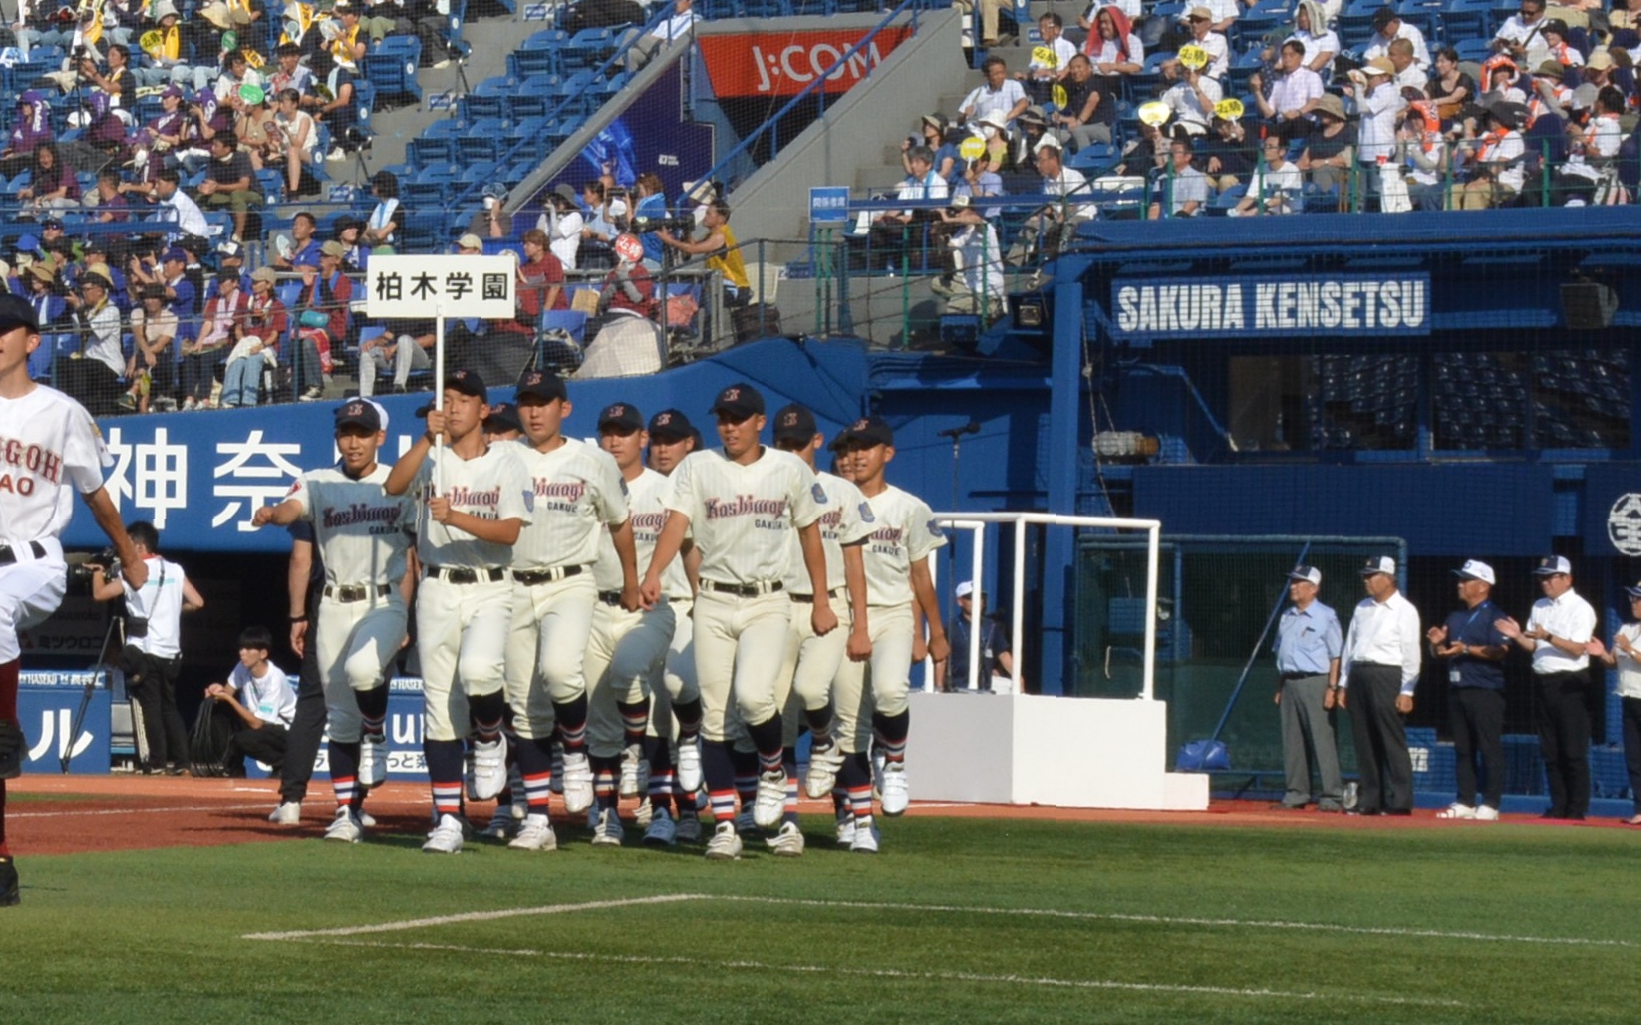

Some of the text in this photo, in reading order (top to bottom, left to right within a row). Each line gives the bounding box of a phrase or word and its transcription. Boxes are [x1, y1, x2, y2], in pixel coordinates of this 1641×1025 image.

[753, 42, 882, 91] J:COM
[376, 271, 508, 301] 柏木学園
[1118, 280, 1424, 331] SAKURA KENSETSU
